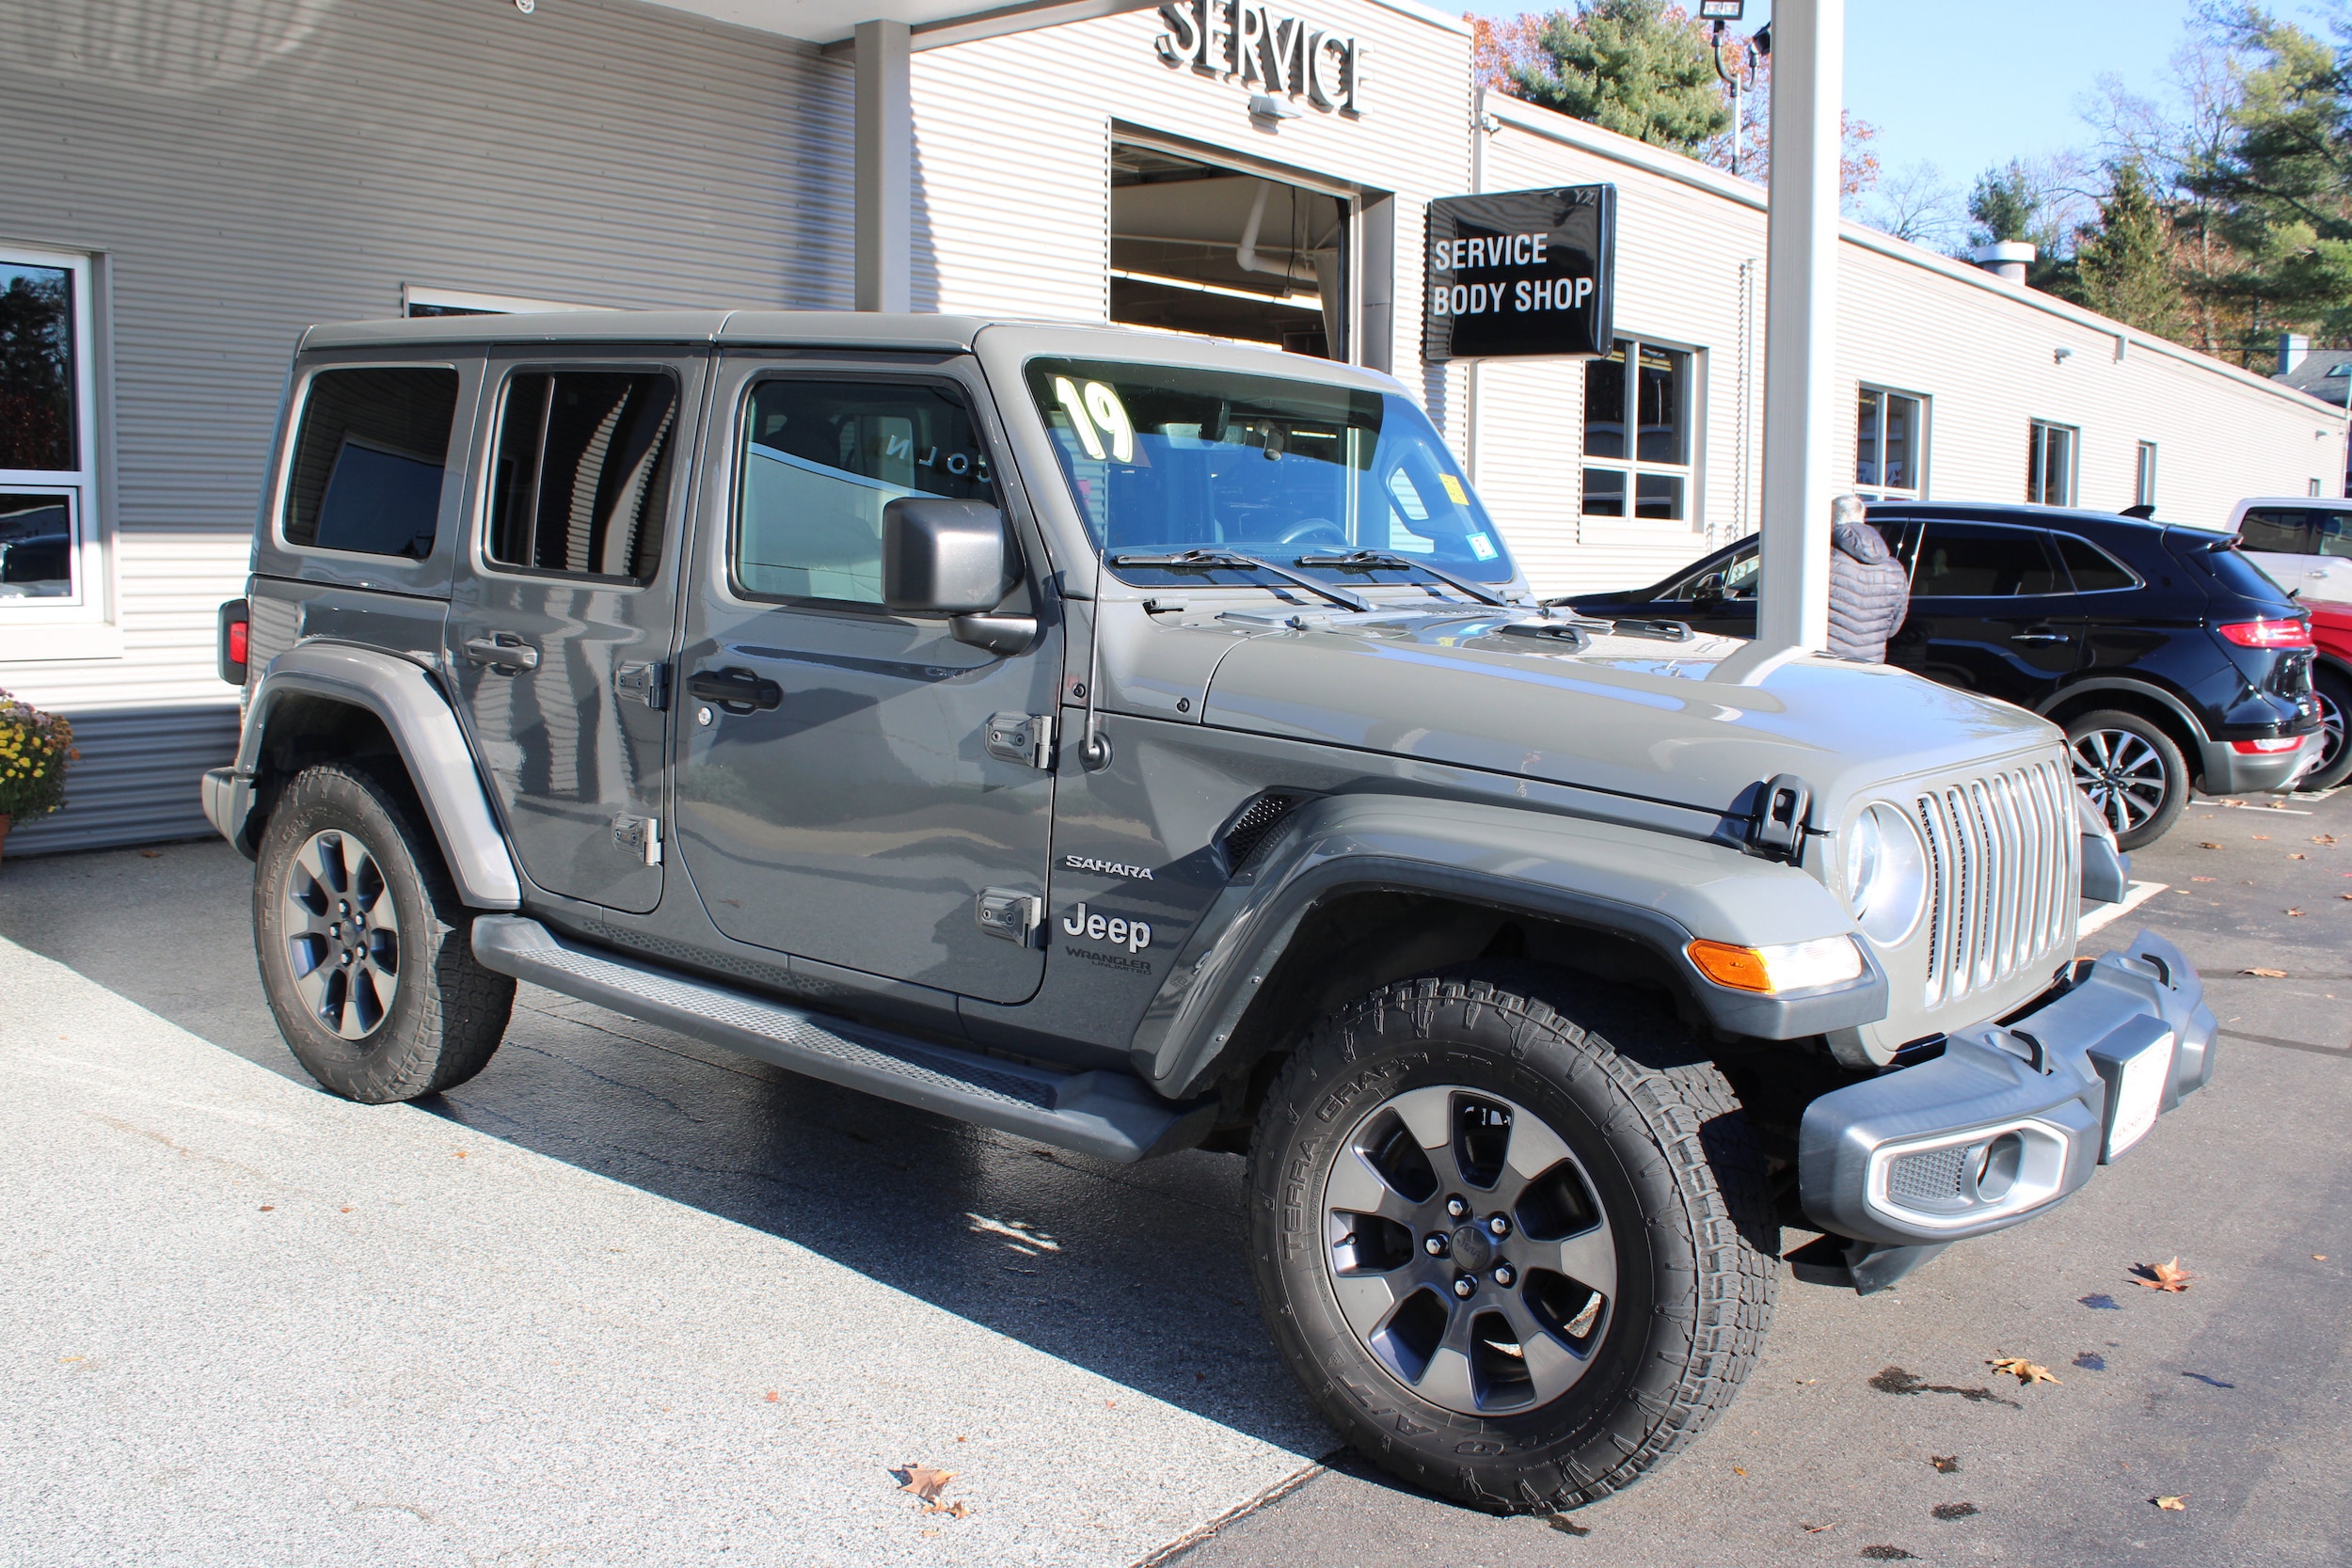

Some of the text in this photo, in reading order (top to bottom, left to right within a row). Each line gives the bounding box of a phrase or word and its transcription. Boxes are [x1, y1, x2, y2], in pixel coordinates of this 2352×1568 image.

[1435, 232, 1549, 271] SERVICE
[1433, 277, 1594, 316] BODY SHOP
[1055, 376, 1134, 463] 19
[1065, 854, 1154, 881] SAHARA
[1063, 902, 1151, 954] Jeep
[1065, 945, 1152, 971] WRANGLER
[1092, 960, 1152, 975] UNLIMITED
[1282, 1136, 1323, 1260] TERRA
